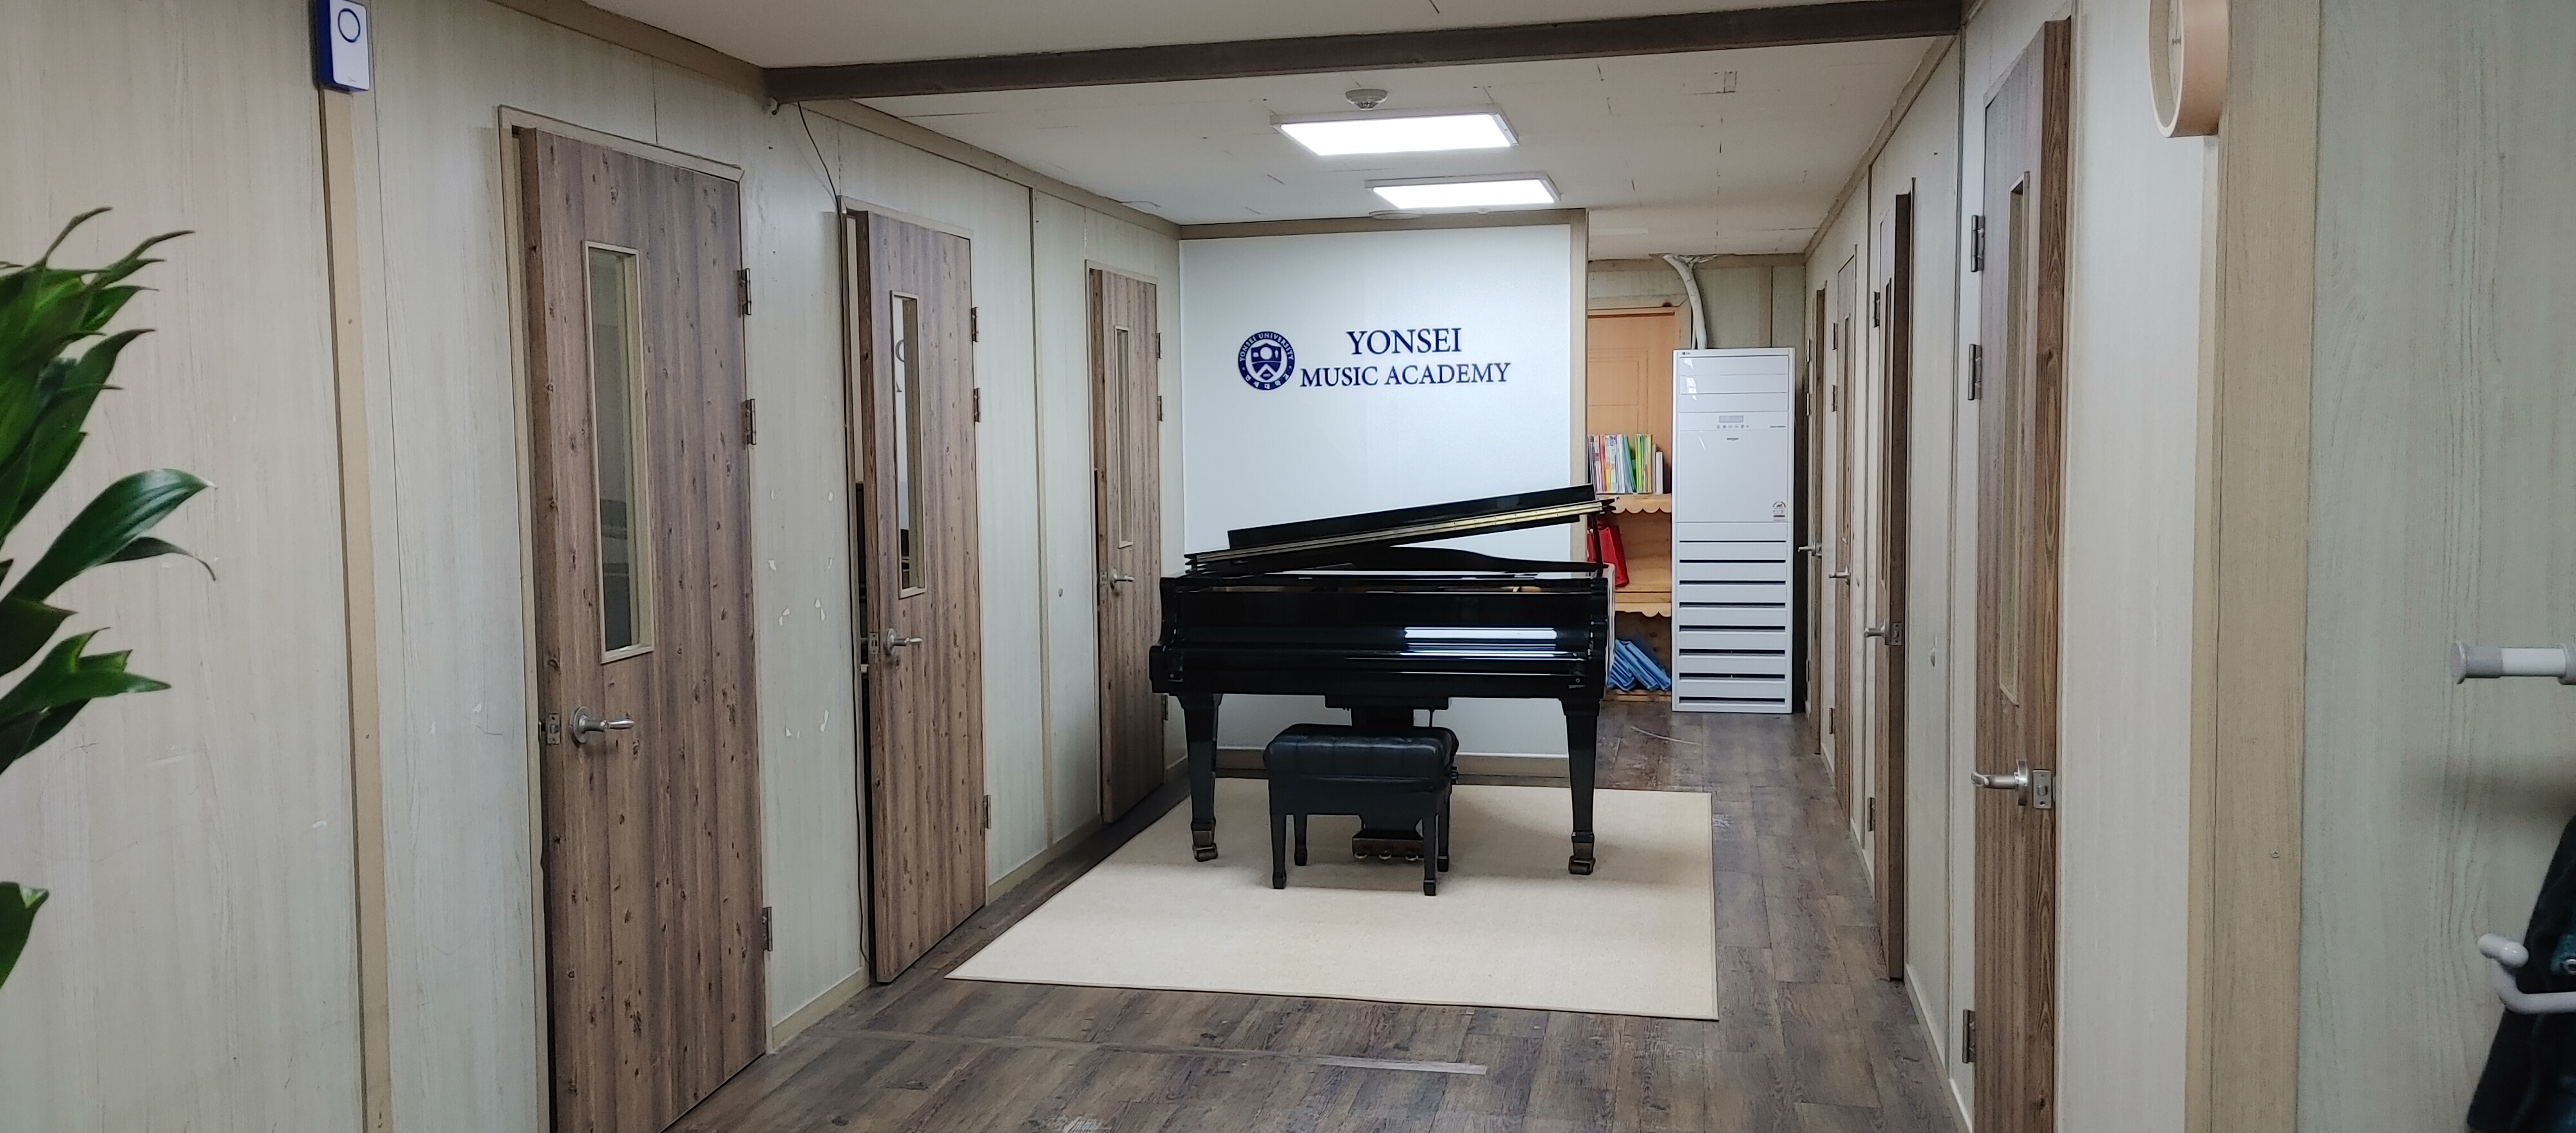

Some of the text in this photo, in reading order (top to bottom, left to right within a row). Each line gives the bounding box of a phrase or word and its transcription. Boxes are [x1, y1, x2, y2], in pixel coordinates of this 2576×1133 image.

[1239, 332, 1294, 362] YONSEI UNIVERSITY
[1345, 327, 1463, 355] YONSEI
[1300, 366, 1378, 388] MUSIC
[1383, 362, 1511, 386] ACADEMY
